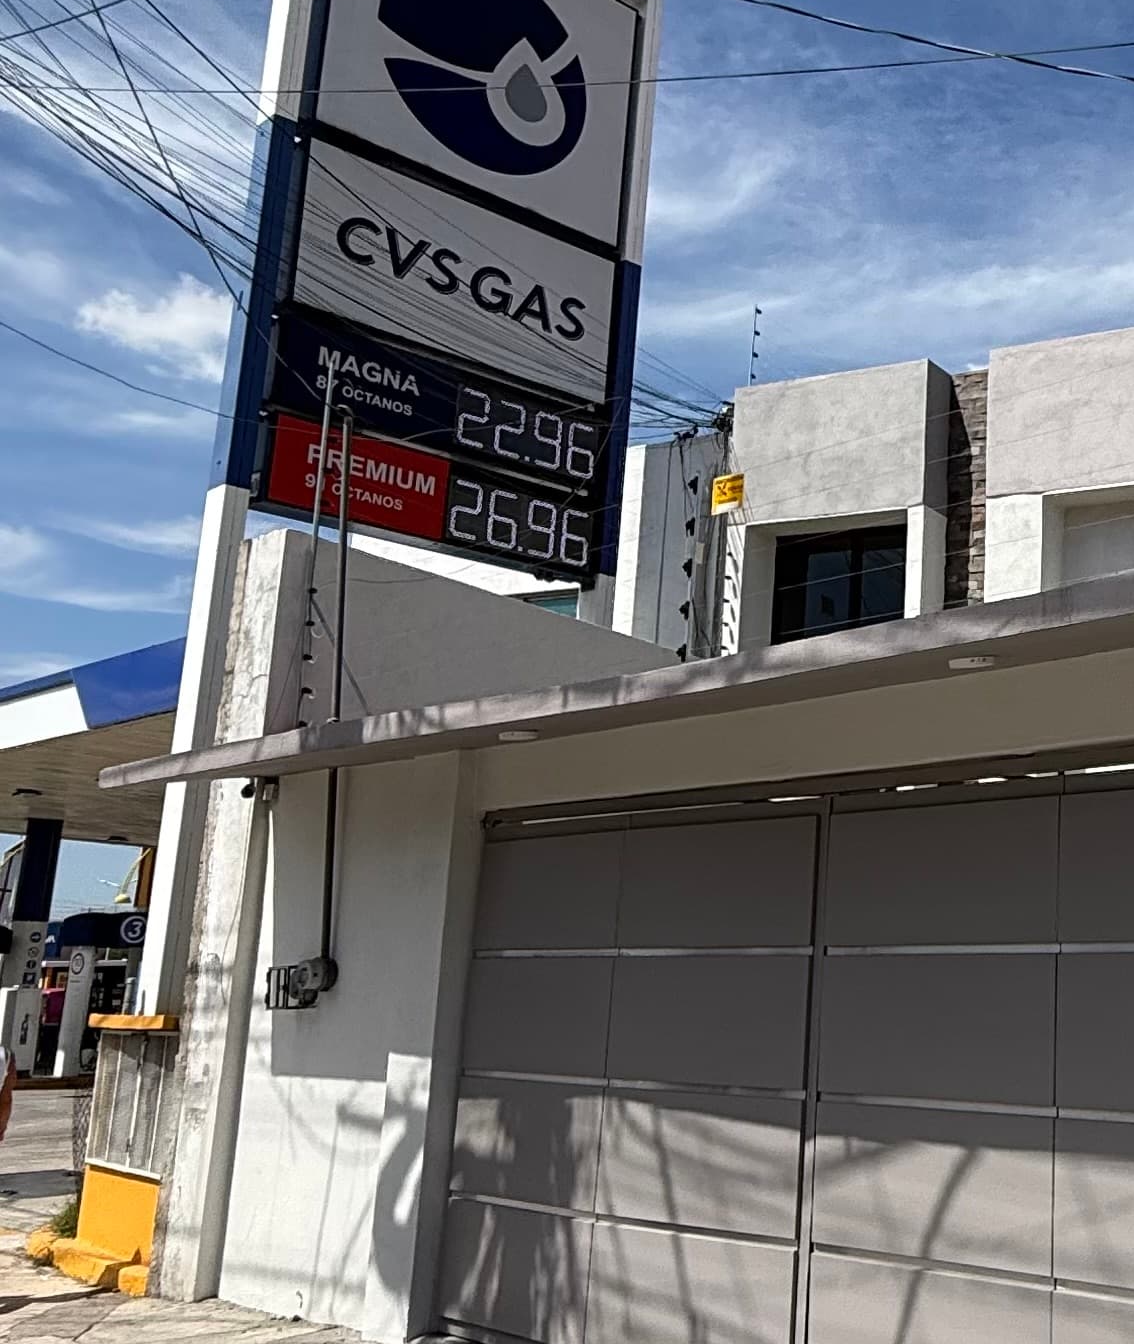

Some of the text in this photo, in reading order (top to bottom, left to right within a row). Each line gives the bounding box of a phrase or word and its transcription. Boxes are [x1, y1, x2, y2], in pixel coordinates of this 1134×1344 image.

[318, 346, 420, 396] MAGNA
[342, 386, 413, 416] OCTANOS
[457, 387, 594, 479] 22.96
[449, 479, 590, 567] 26.96
[127, 921, 144, 938] 3
